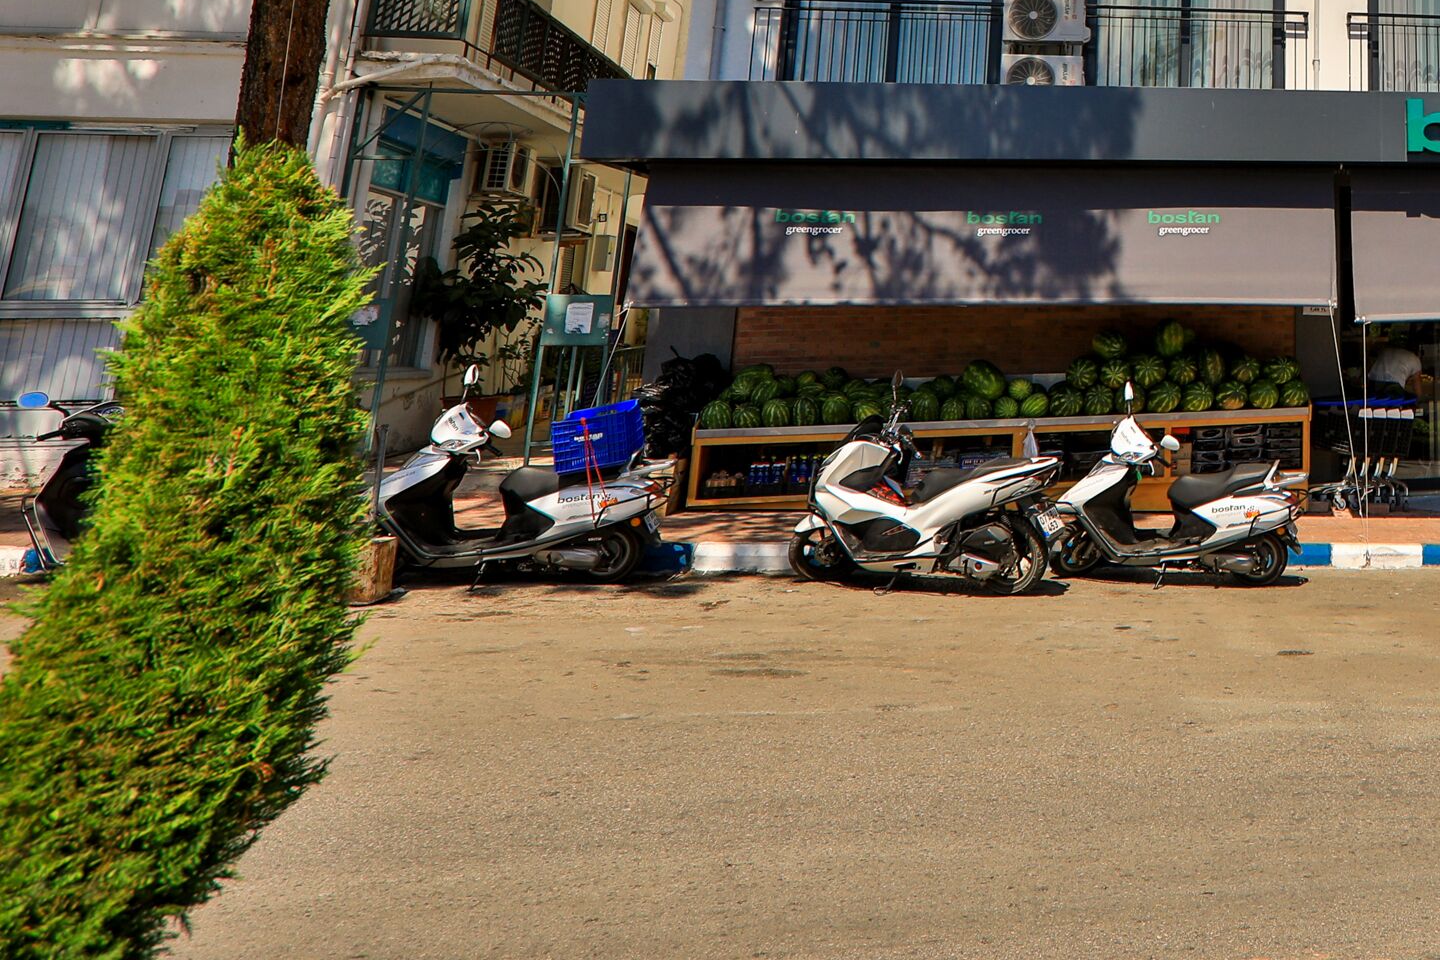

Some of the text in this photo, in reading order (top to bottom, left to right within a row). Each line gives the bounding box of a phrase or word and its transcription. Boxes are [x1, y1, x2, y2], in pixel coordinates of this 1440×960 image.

[774, 209, 856, 224] bostan
[966, 210, 1043, 225] bostan
[1147, 210, 1221, 224] bostan
[785, 225, 843, 236] greengrocer
[976, 226, 1031, 237] greengrocer
[1158, 226, 1210, 237] greengrocer
[1211, 504, 1246, 514] bostan
